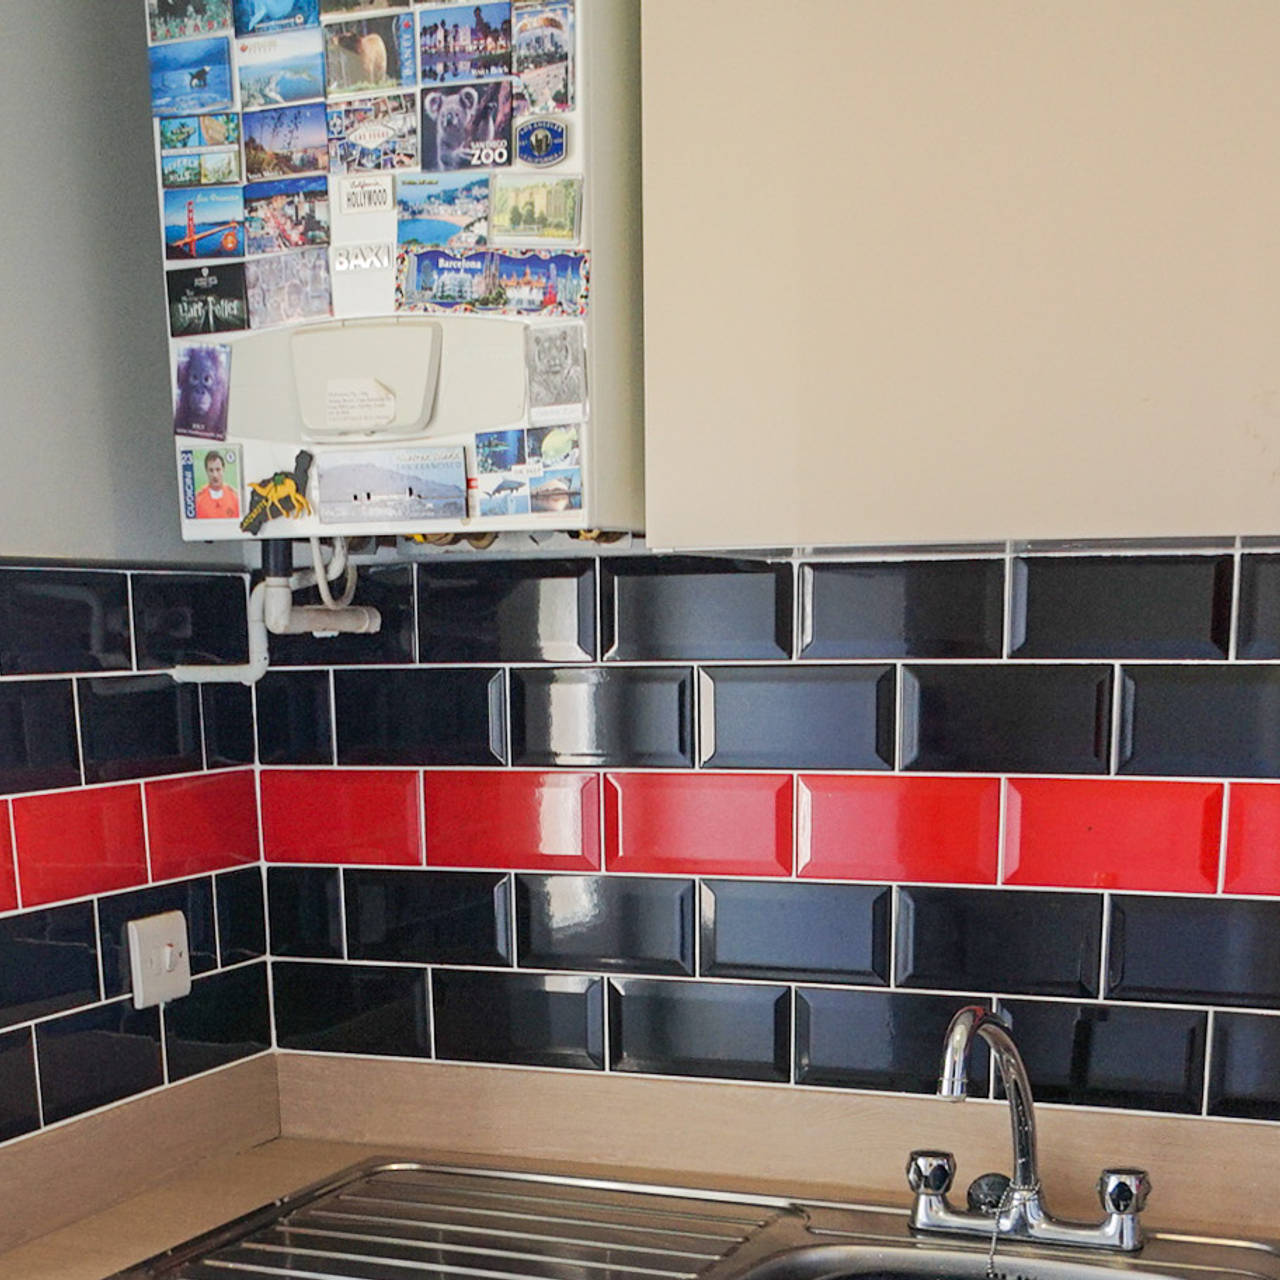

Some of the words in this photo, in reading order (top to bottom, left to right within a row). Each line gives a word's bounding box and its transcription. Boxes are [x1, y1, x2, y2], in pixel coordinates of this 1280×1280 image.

[471, 148, 508, 165] ZOO
[346, 187, 388, 208] HOLLYWOOD
[335, 246, 391, 271] BAXI
[437, 257, 482, 271] Barcelona
